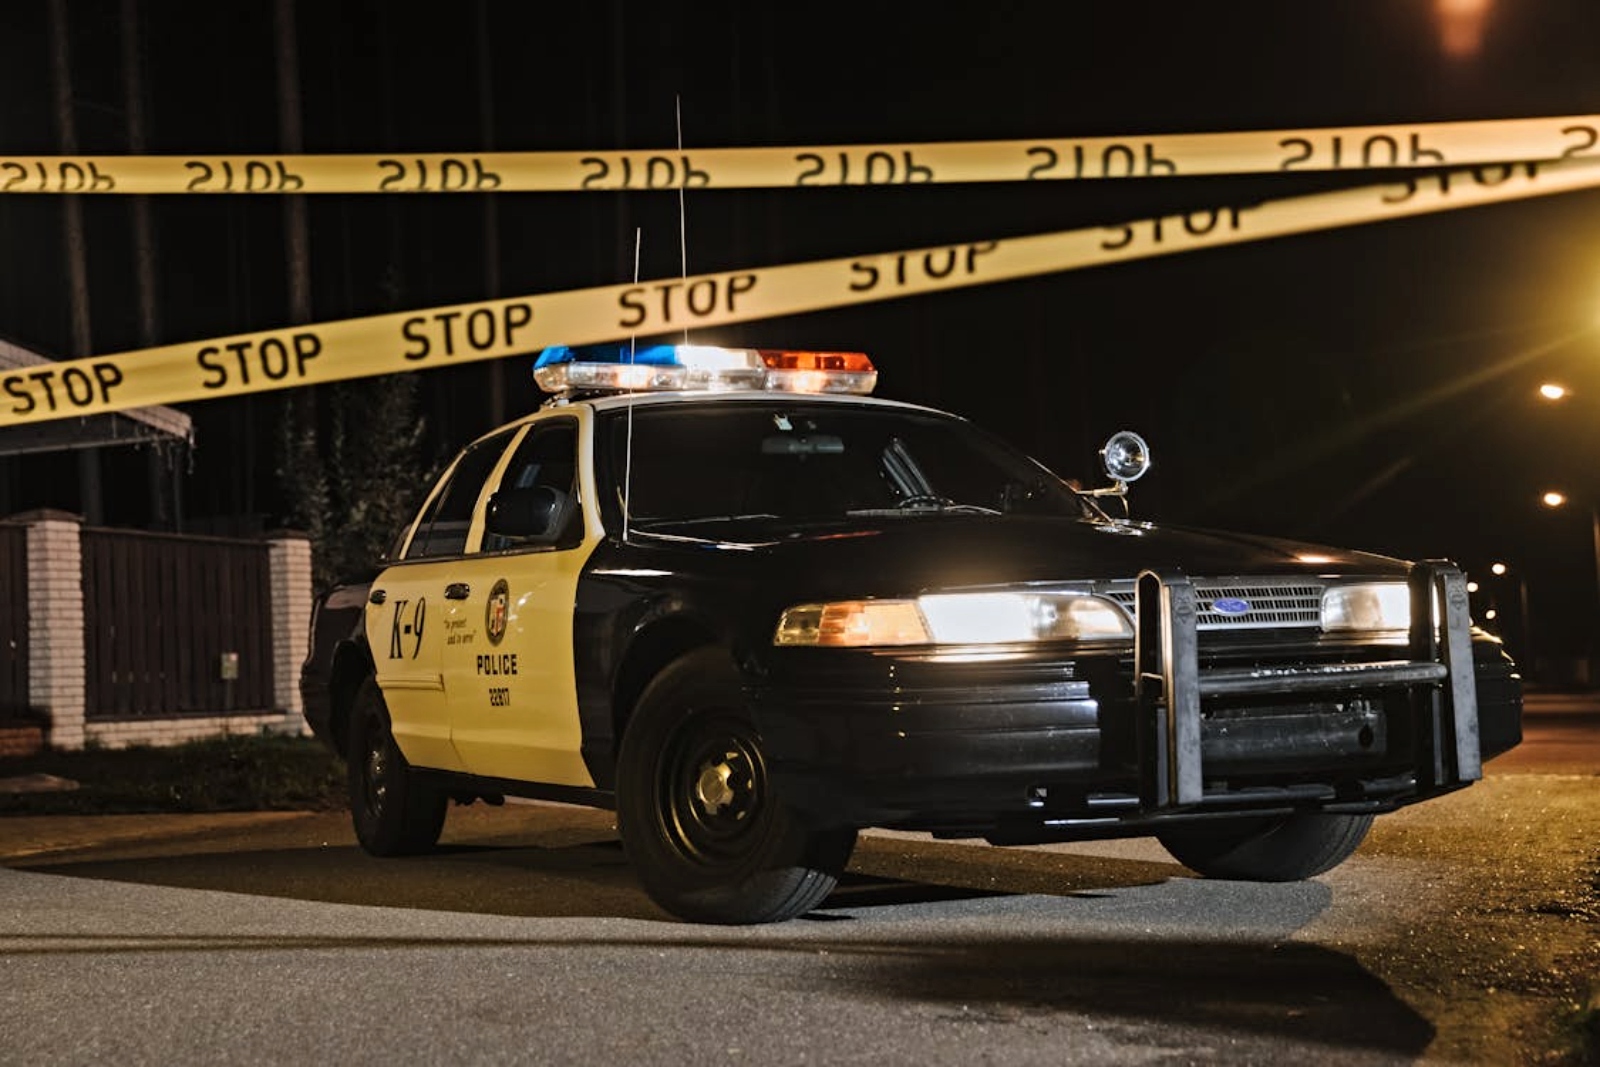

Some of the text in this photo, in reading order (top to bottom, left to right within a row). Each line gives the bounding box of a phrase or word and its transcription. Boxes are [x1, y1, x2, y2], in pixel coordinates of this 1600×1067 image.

[2, 362, 123, 415] STOP
[197, 332, 322, 389] STOP
[401, 303, 532, 361] STOP
[618, 274, 757, 328] STOP
[849, 241, 999, 292] STOP
[389, 596, 426, 660] K-9
[477, 653, 518, 675] POLICE
